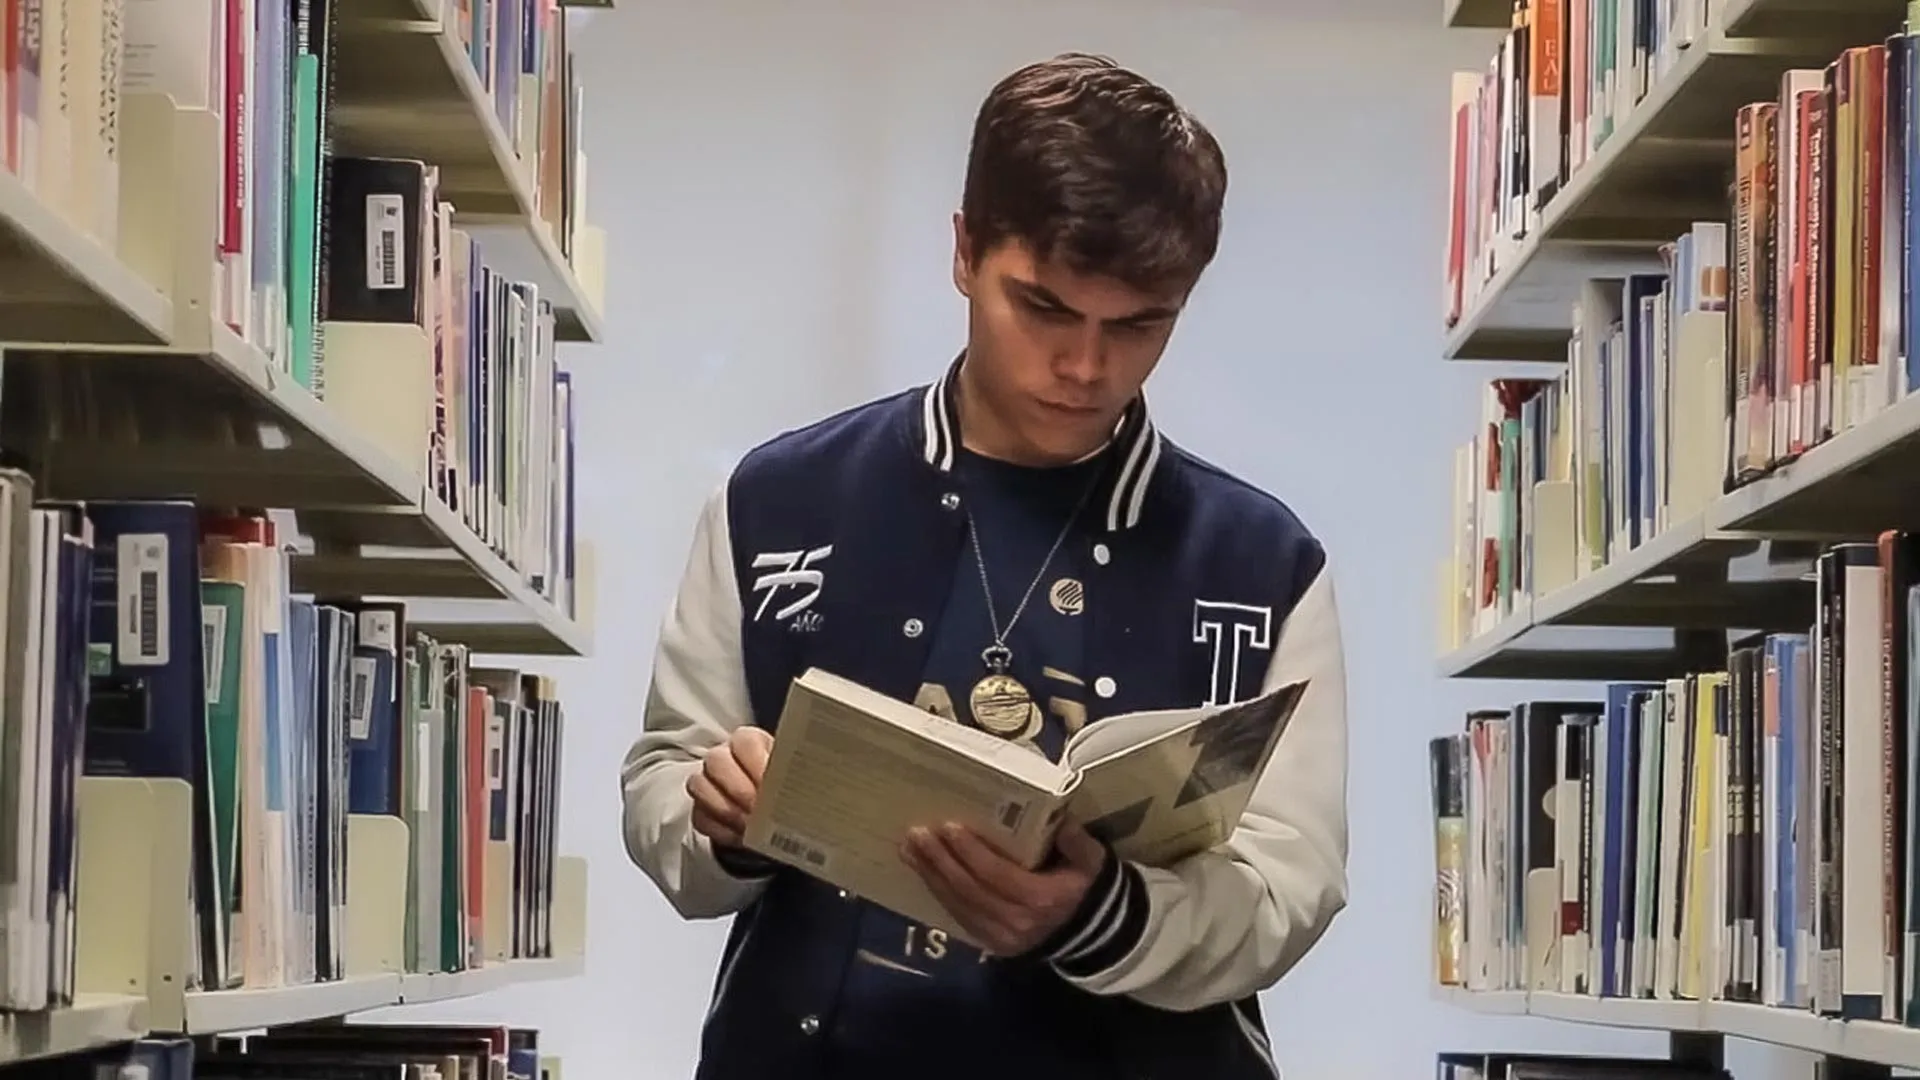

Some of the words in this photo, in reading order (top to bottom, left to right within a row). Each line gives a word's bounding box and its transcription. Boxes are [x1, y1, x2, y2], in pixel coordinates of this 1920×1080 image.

[1809, 127, 1821, 172] Total
[1809, 176, 1820, 241] Quality
[751, 544, 833, 622] 75
[1193, 598, 1271, 706] T
[905, 925, 948, 960] IS
